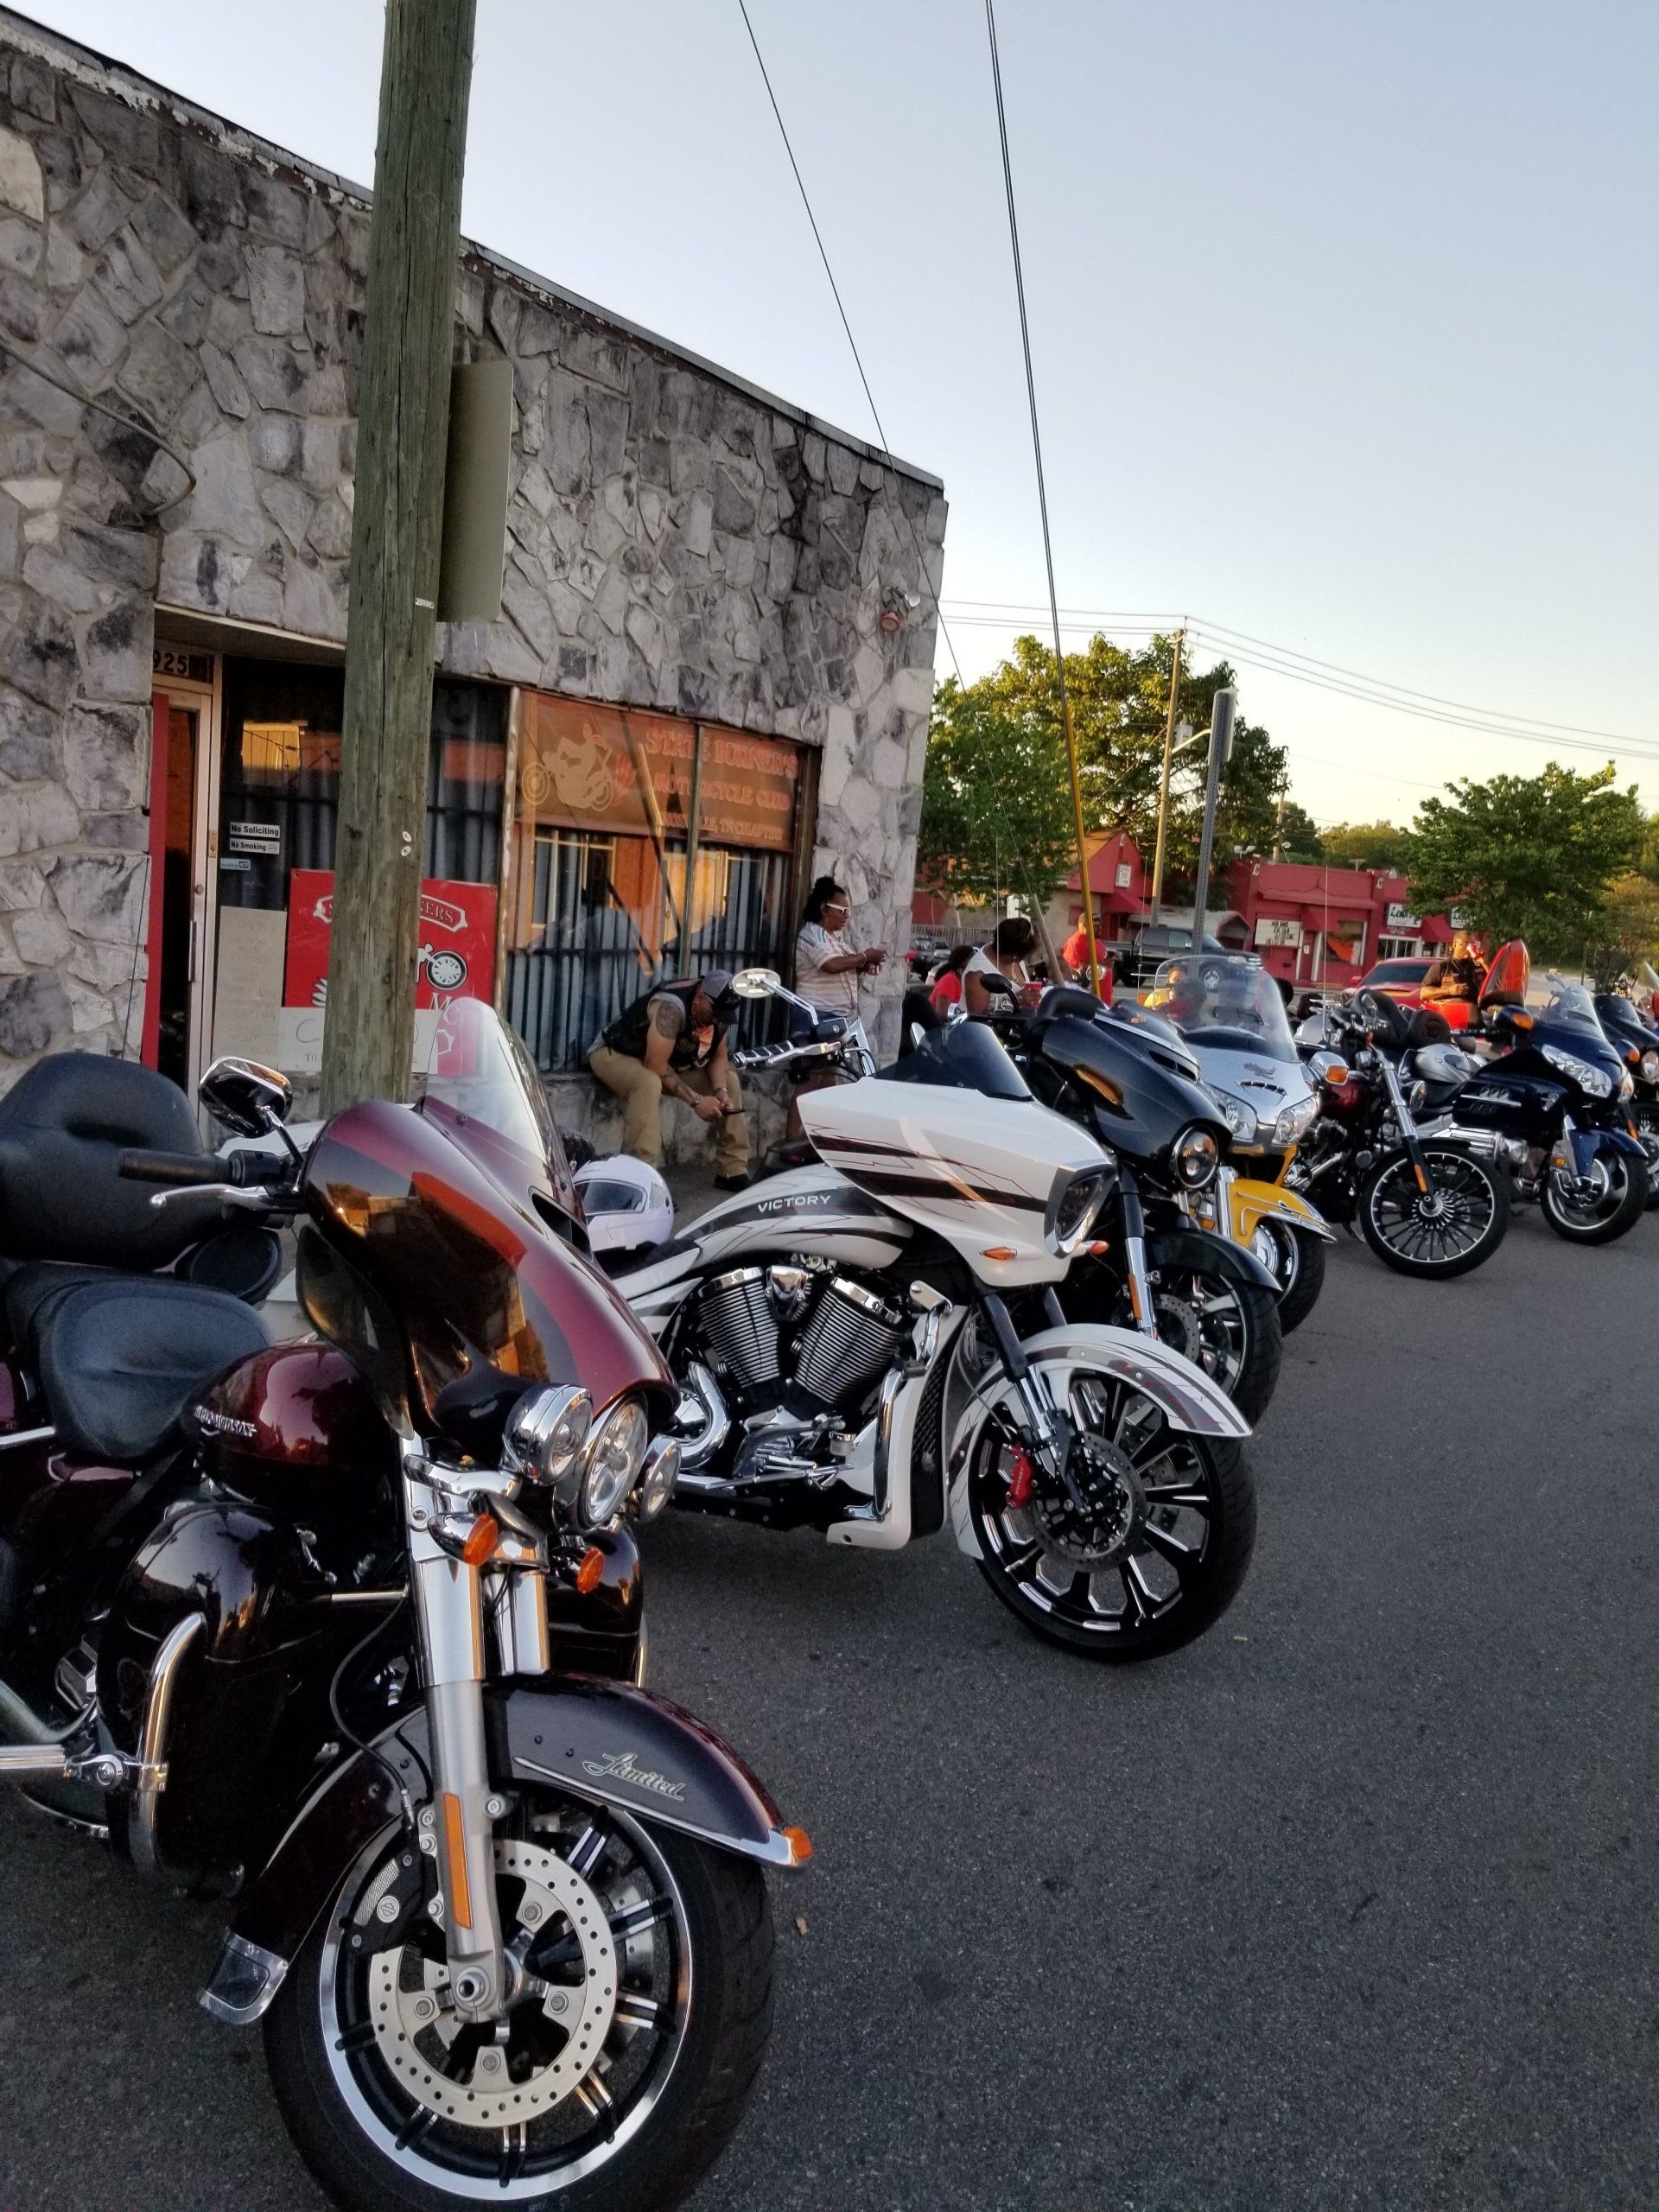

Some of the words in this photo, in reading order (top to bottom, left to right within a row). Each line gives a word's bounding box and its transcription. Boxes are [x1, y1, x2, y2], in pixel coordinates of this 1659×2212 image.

[653, 772, 754, 806] MOTRCYCLE
[244, 825, 279, 837] Soliciting
[240, 842, 267, 852] Smoking
[758, 1195, 831, 1213] VICTORY
[582, 1752, 686, 1802] Limited
